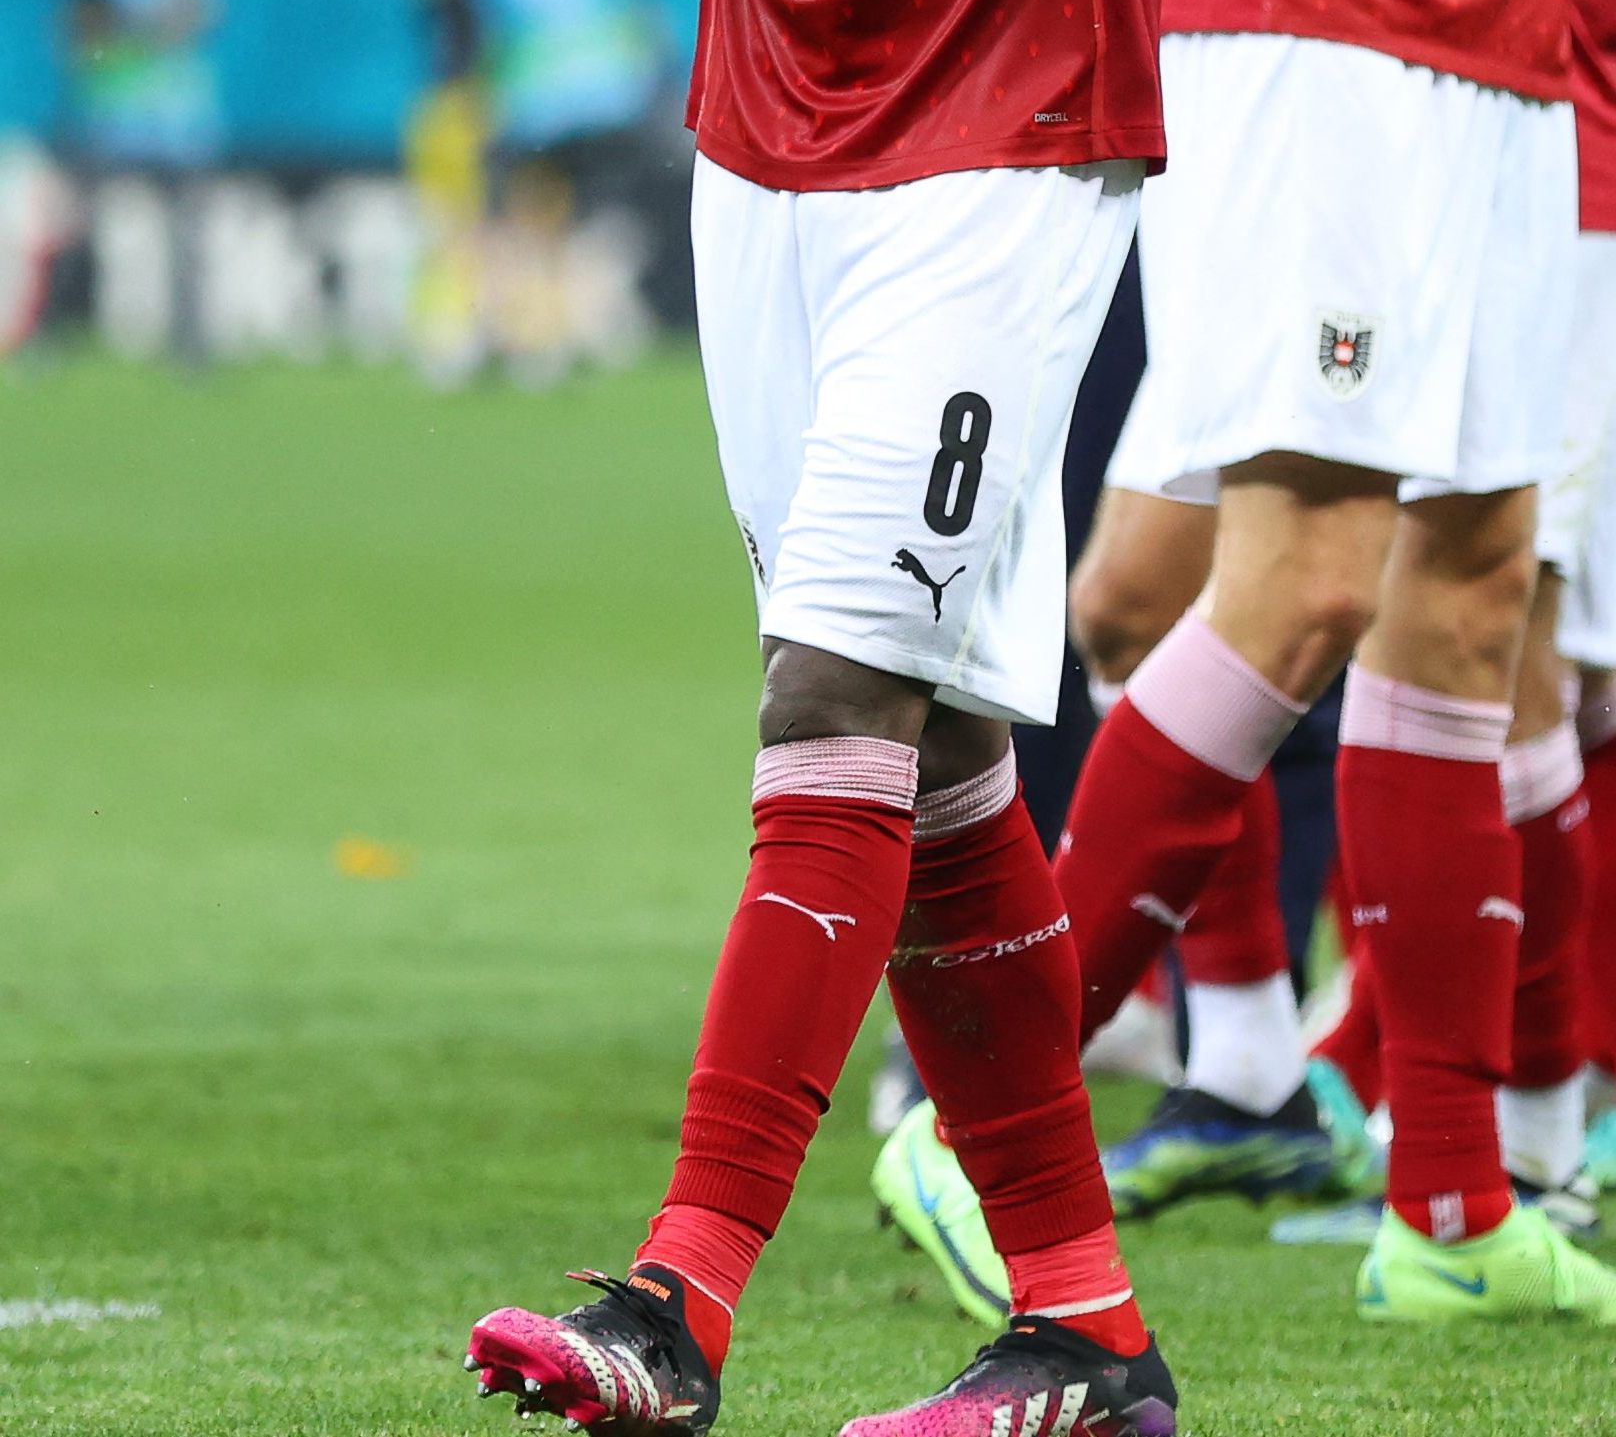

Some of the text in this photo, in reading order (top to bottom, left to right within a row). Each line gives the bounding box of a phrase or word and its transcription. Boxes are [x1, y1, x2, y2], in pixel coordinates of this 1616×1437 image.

[1034, 113, 1068, 123] DRYCELL
[923, 391, 992, 537] 8
[628, 1275, 671, 1302] PREDATOR
